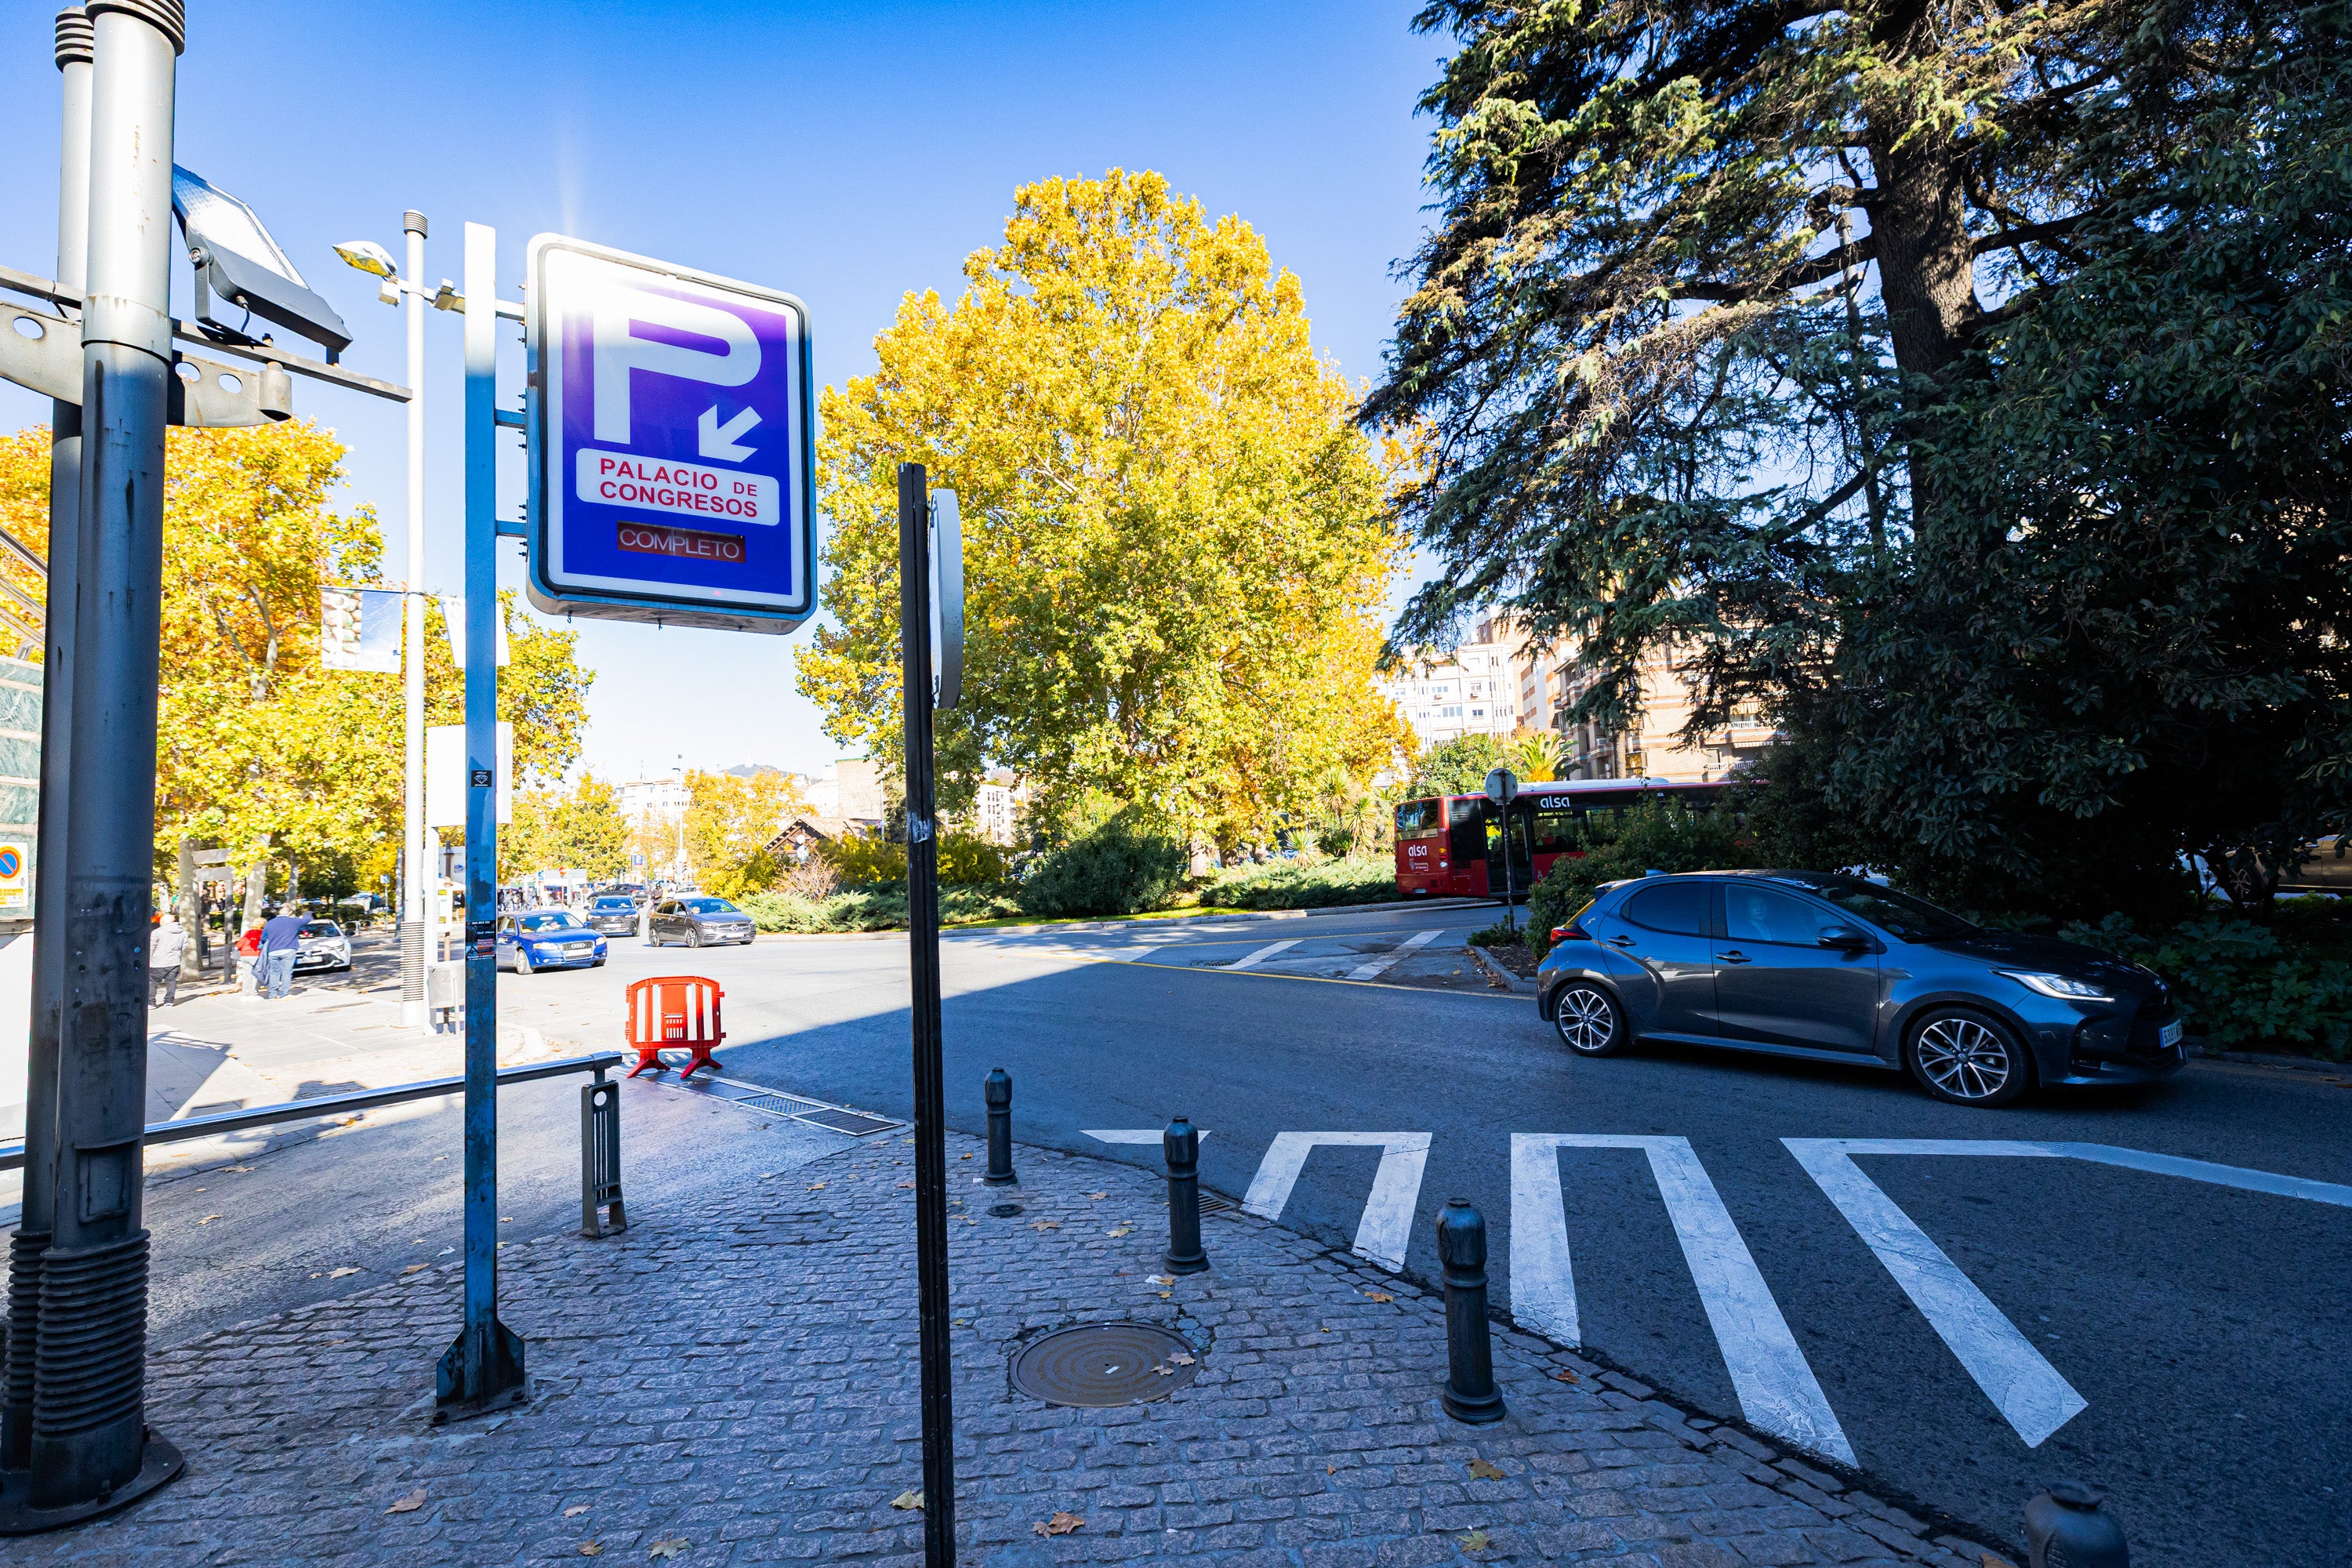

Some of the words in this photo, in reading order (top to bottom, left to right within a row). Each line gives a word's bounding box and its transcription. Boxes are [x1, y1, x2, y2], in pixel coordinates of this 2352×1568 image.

[593, 281, 762, 445] P
[601, 458, 718, 491] PALACIO
[734, 481, 758, 497] DE
[601, 481, 758, 518] CONGRESOS
[619, 528, 740, 560] COMPLETO
[1540, 795, 1570, 808] alsa
[1408, 844, 1427, 857] alsa
